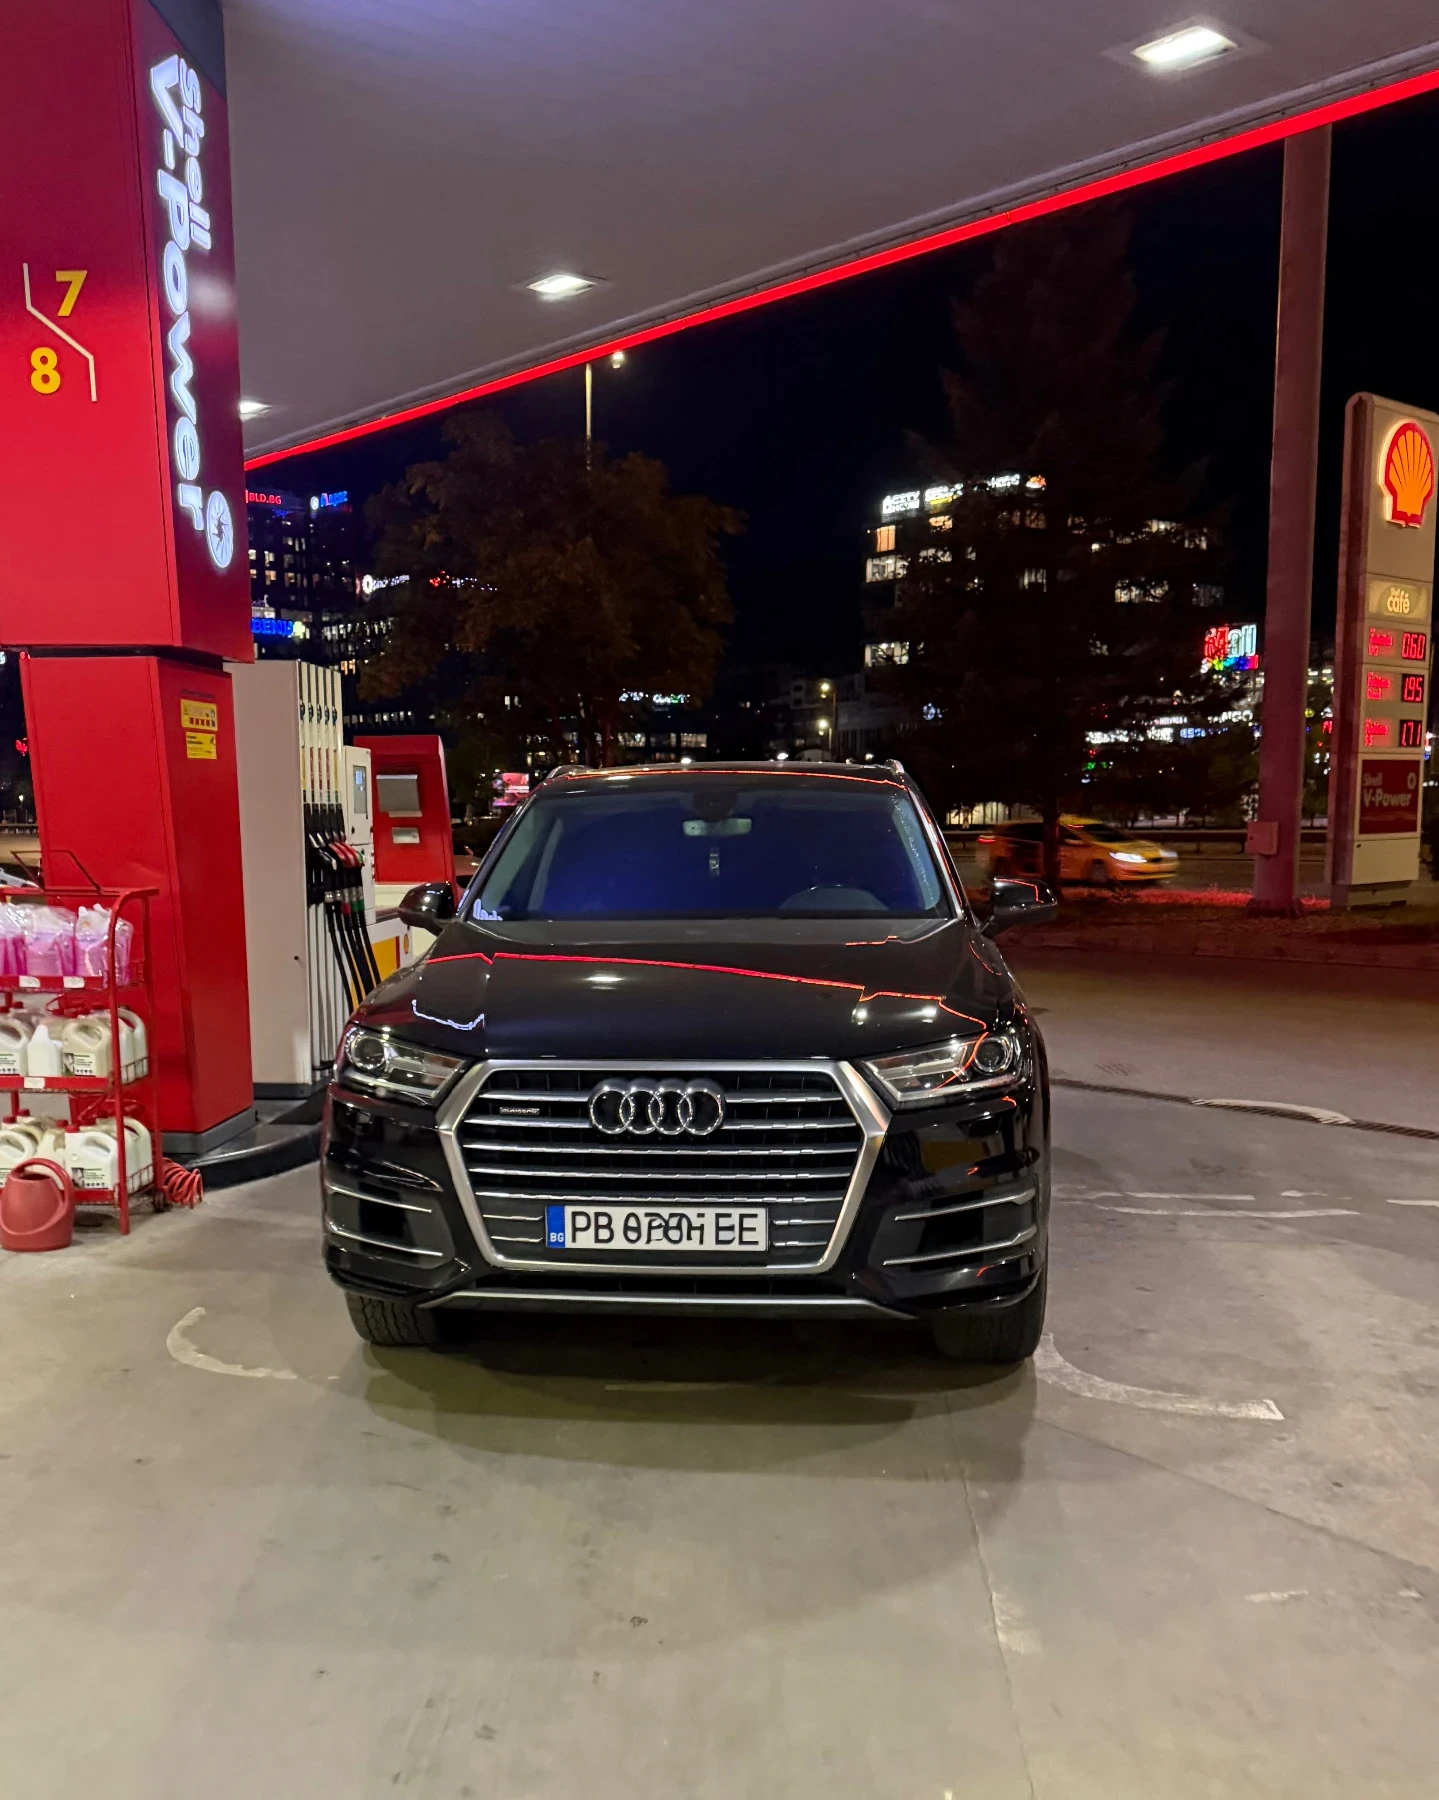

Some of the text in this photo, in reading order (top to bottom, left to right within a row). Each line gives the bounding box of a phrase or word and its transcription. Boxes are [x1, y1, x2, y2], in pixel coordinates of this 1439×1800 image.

[180, 58, 211, 250] Shell
[56, 270, 88, 317] 7
[150, 54, 204, 531] V-Power
[31, 347, 61, 394] 8
[1363, 788, 1412, 808] V-Power
[550, 1232, 564, 1243] BG
[571, 1211, 614, 1244] PB
[715, 1212, 760, 1246] EE
